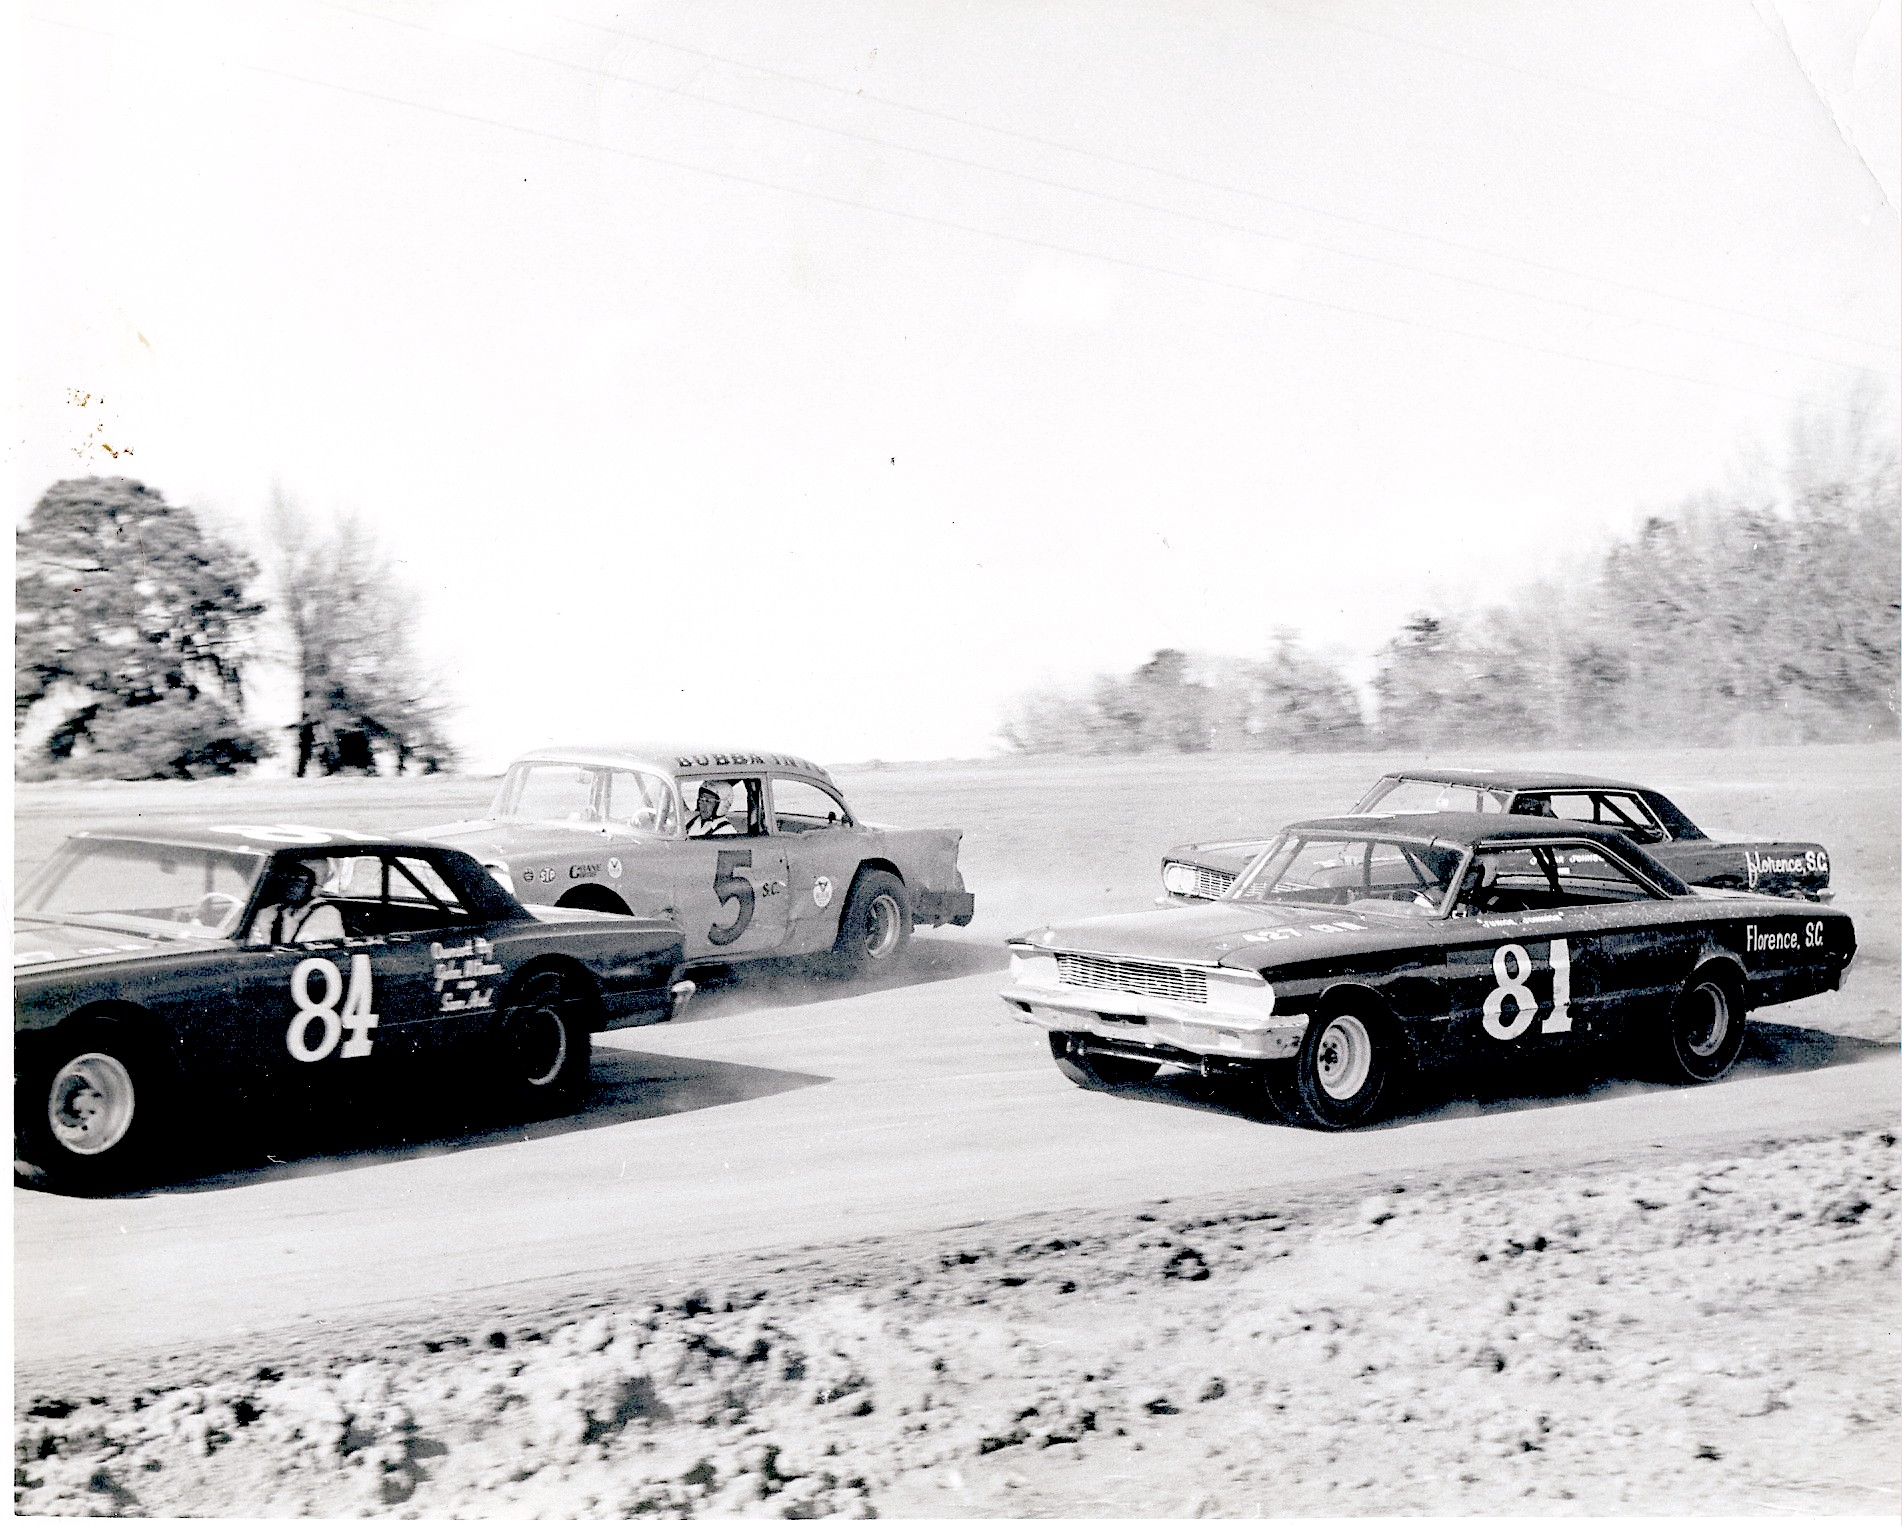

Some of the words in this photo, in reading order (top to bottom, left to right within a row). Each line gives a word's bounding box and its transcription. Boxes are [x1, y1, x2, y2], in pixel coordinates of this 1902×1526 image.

[540, 868, 556, 881] STP
[707, 849, 755, 946] 5
[286, 954, 379, 1063] 84
[1482, 938, 1573, 1040] 81
